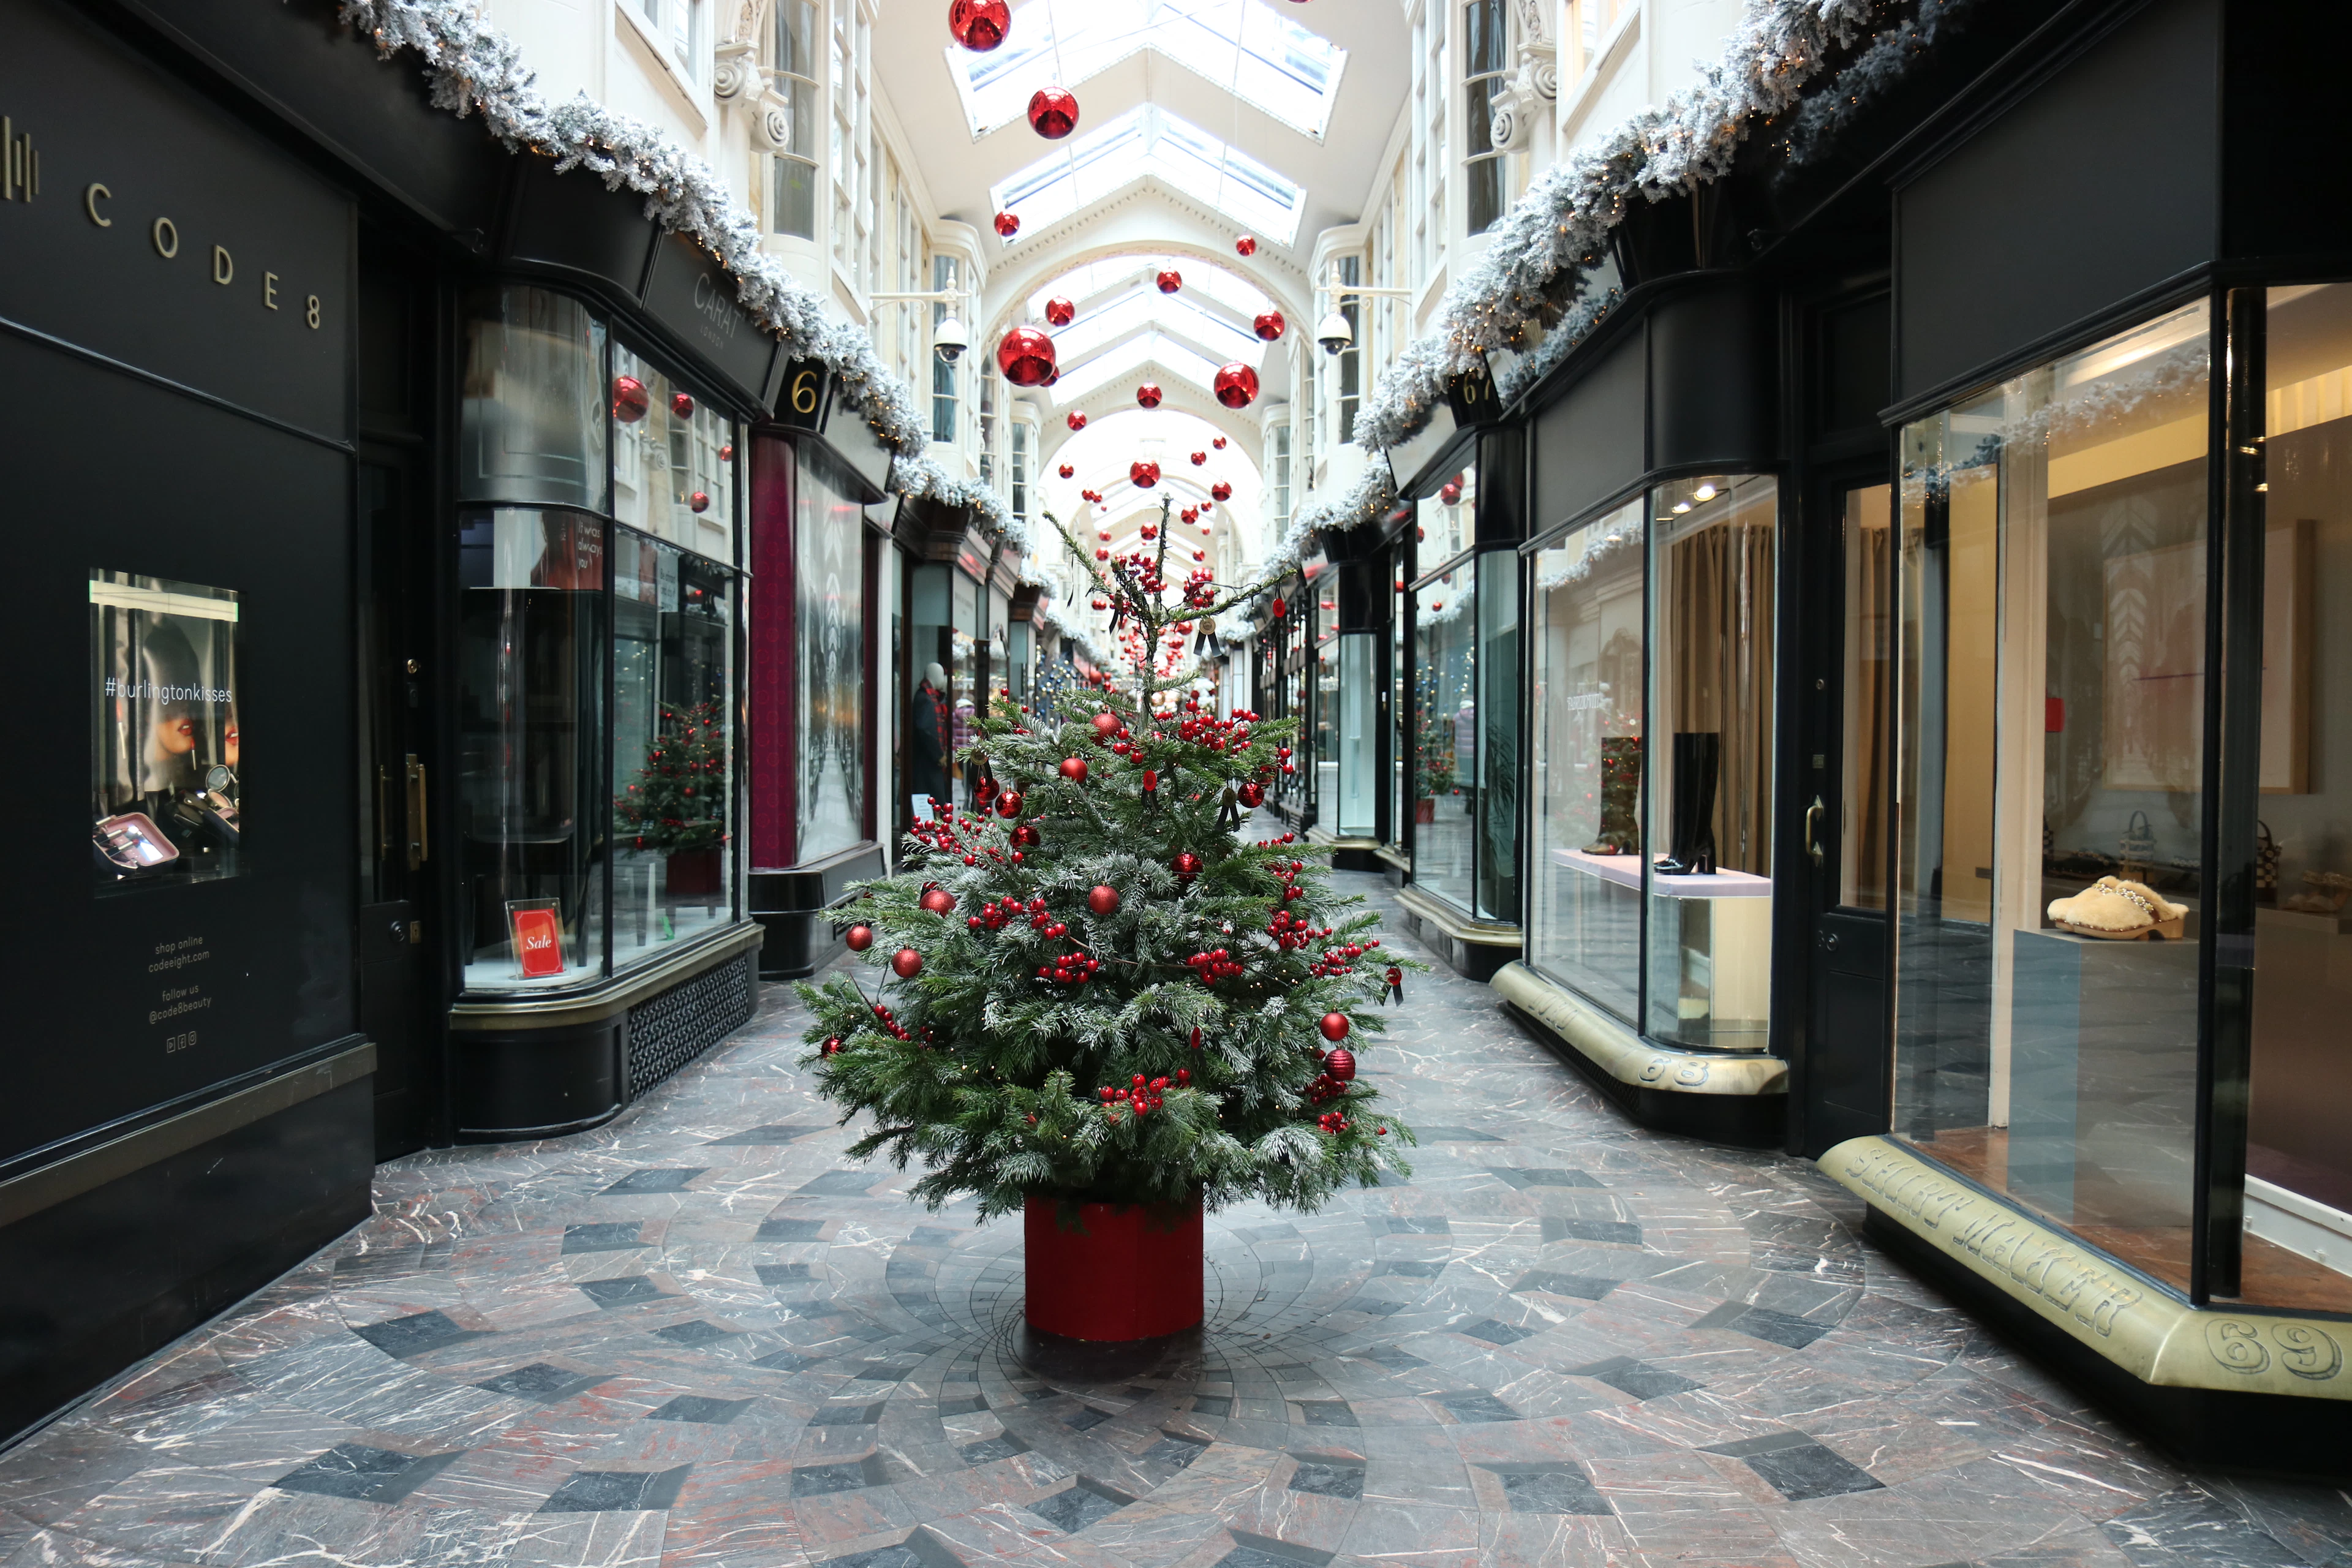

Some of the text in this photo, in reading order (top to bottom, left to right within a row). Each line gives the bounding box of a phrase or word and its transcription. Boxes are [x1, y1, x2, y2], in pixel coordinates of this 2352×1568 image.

[792, 370, 817, 413] 6
[105, 677, 232, 705] #burlingtonkisses
[155, 936, 203, 954] shop online
[526, 935, 552, 950] Sale
[148, 950, 210, 973] codeeight.com
[162, 985, 199, 1002] follow us
[149, 997, 212, 1025] @code8beauty
[1638, 1054, 1709, 1087] 68
[1844, 1147, 2144, 1338] SHIRT MAKER
[2206, 1318, 2344, 1381] 69
